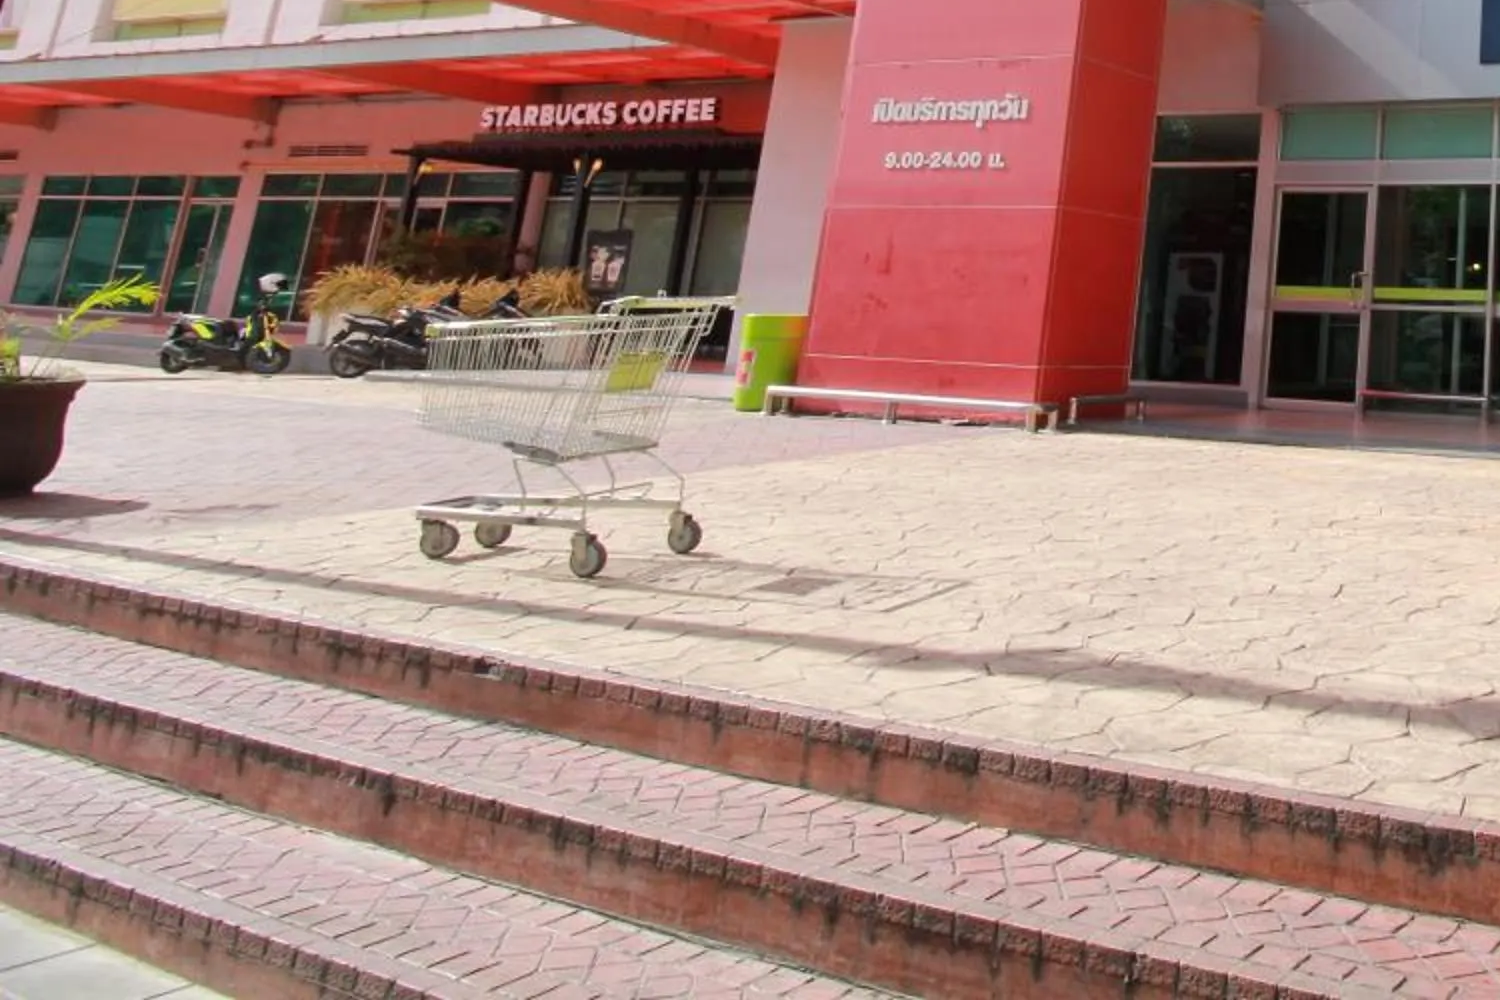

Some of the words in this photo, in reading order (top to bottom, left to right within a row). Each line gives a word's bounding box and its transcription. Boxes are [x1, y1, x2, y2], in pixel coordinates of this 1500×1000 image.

[480, 102, 617, 128] STARBUCKS
[622, 97, 716, 124] COFFEE
[872, 94, 1029, 127] เปิดบริการทุกวัน
[884, 151, 982, 169] 9.00-24.00
